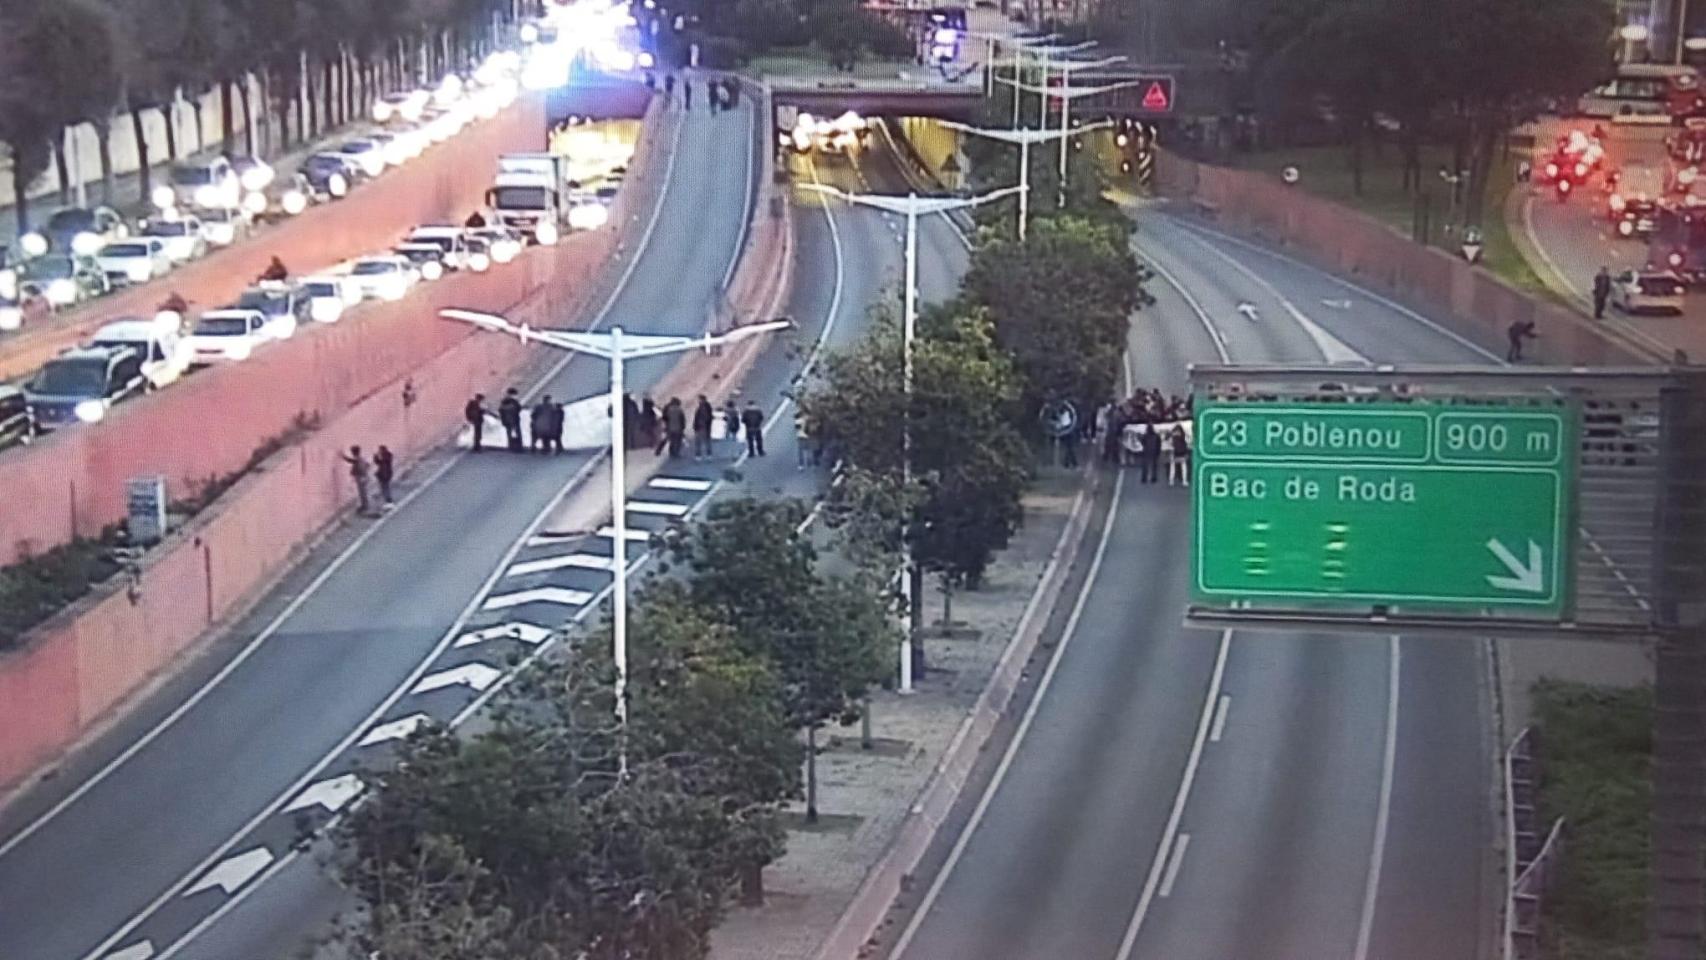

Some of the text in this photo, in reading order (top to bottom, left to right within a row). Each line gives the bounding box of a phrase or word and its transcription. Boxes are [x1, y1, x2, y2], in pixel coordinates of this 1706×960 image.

[1211, 421, 1248, 446] 23
[1265, 422, 1402, 449] Poblenou
[1447, 424, 1551, 452] 900 m
[1210, 473, 1416, 502] Bac de Roda
